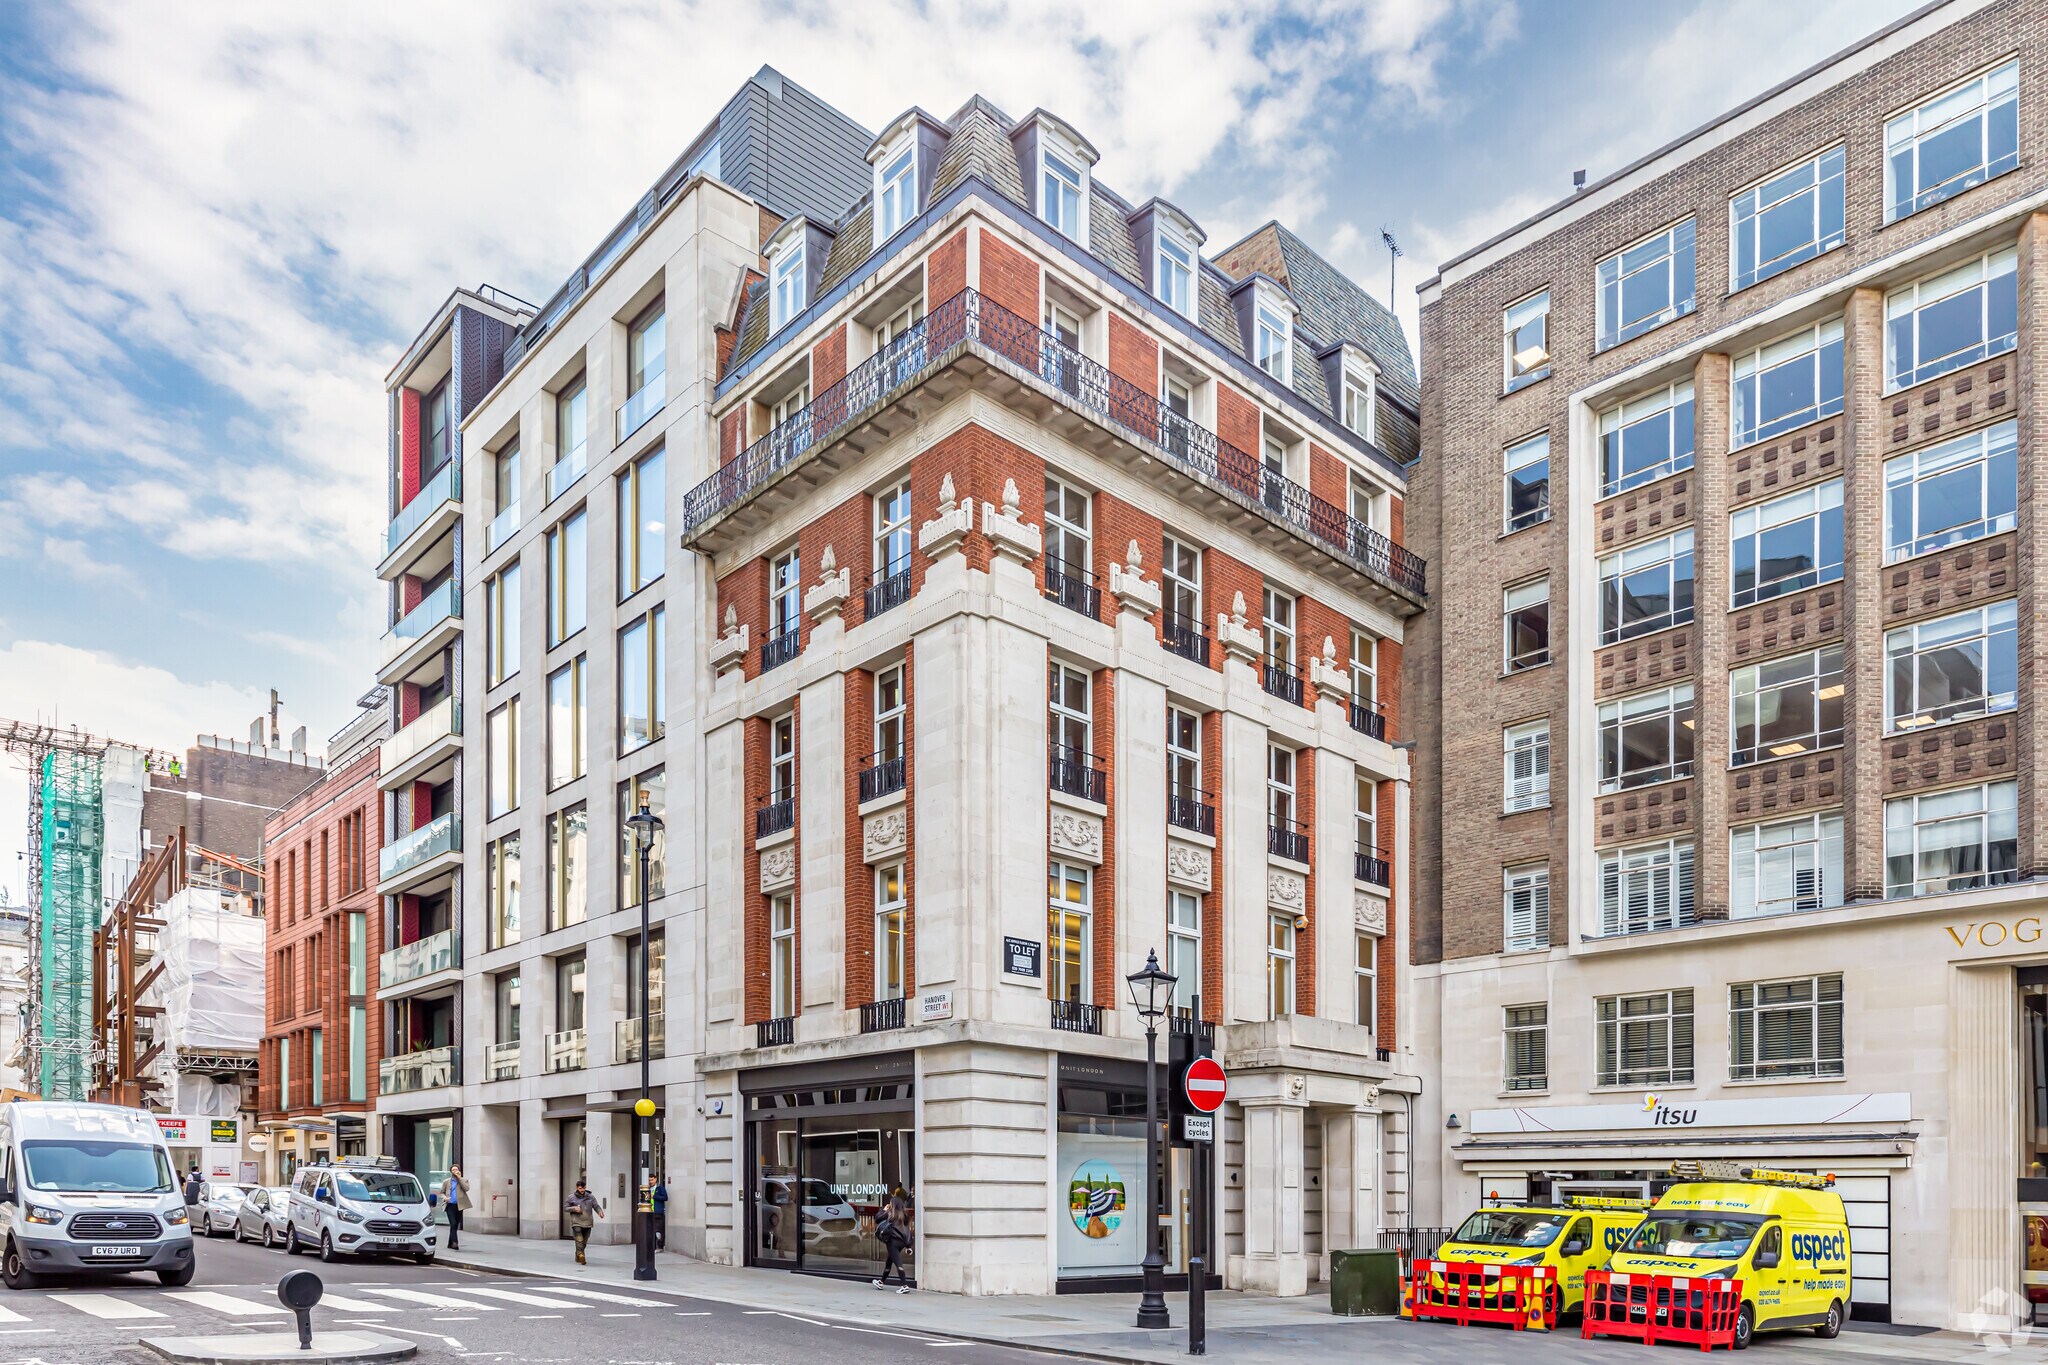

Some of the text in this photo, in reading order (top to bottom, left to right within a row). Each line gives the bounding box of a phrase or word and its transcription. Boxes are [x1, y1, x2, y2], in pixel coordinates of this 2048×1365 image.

[1943, 918, 2043, 948] VOG
[1009, 944, 1036, 957] TO LET
[924, 995, 946, 1004] HANOVER
[924, 1004, 941, 1012] STREET
[1654, 1105, 1697, 1126] itsu
[1187, 1118, 1210, 1129] Except
[1188, 1129, 1209, 1137] cycles
[596, 1136, 602, 1155] 8
[830, 1183, 888, 1195] UNIT LONDON
[1450, 1248, 1510, 1259] aspect
[1791, 1230, 1846, 1269] aspect
[1626, 1259, 1699, 1270] aspect
[1803, 1279, 1846, 1292] help made easy
[1759, 1289, 1780, 1297] aspect.co.uk
[1631, 1305, 1646, 1313] KM6
